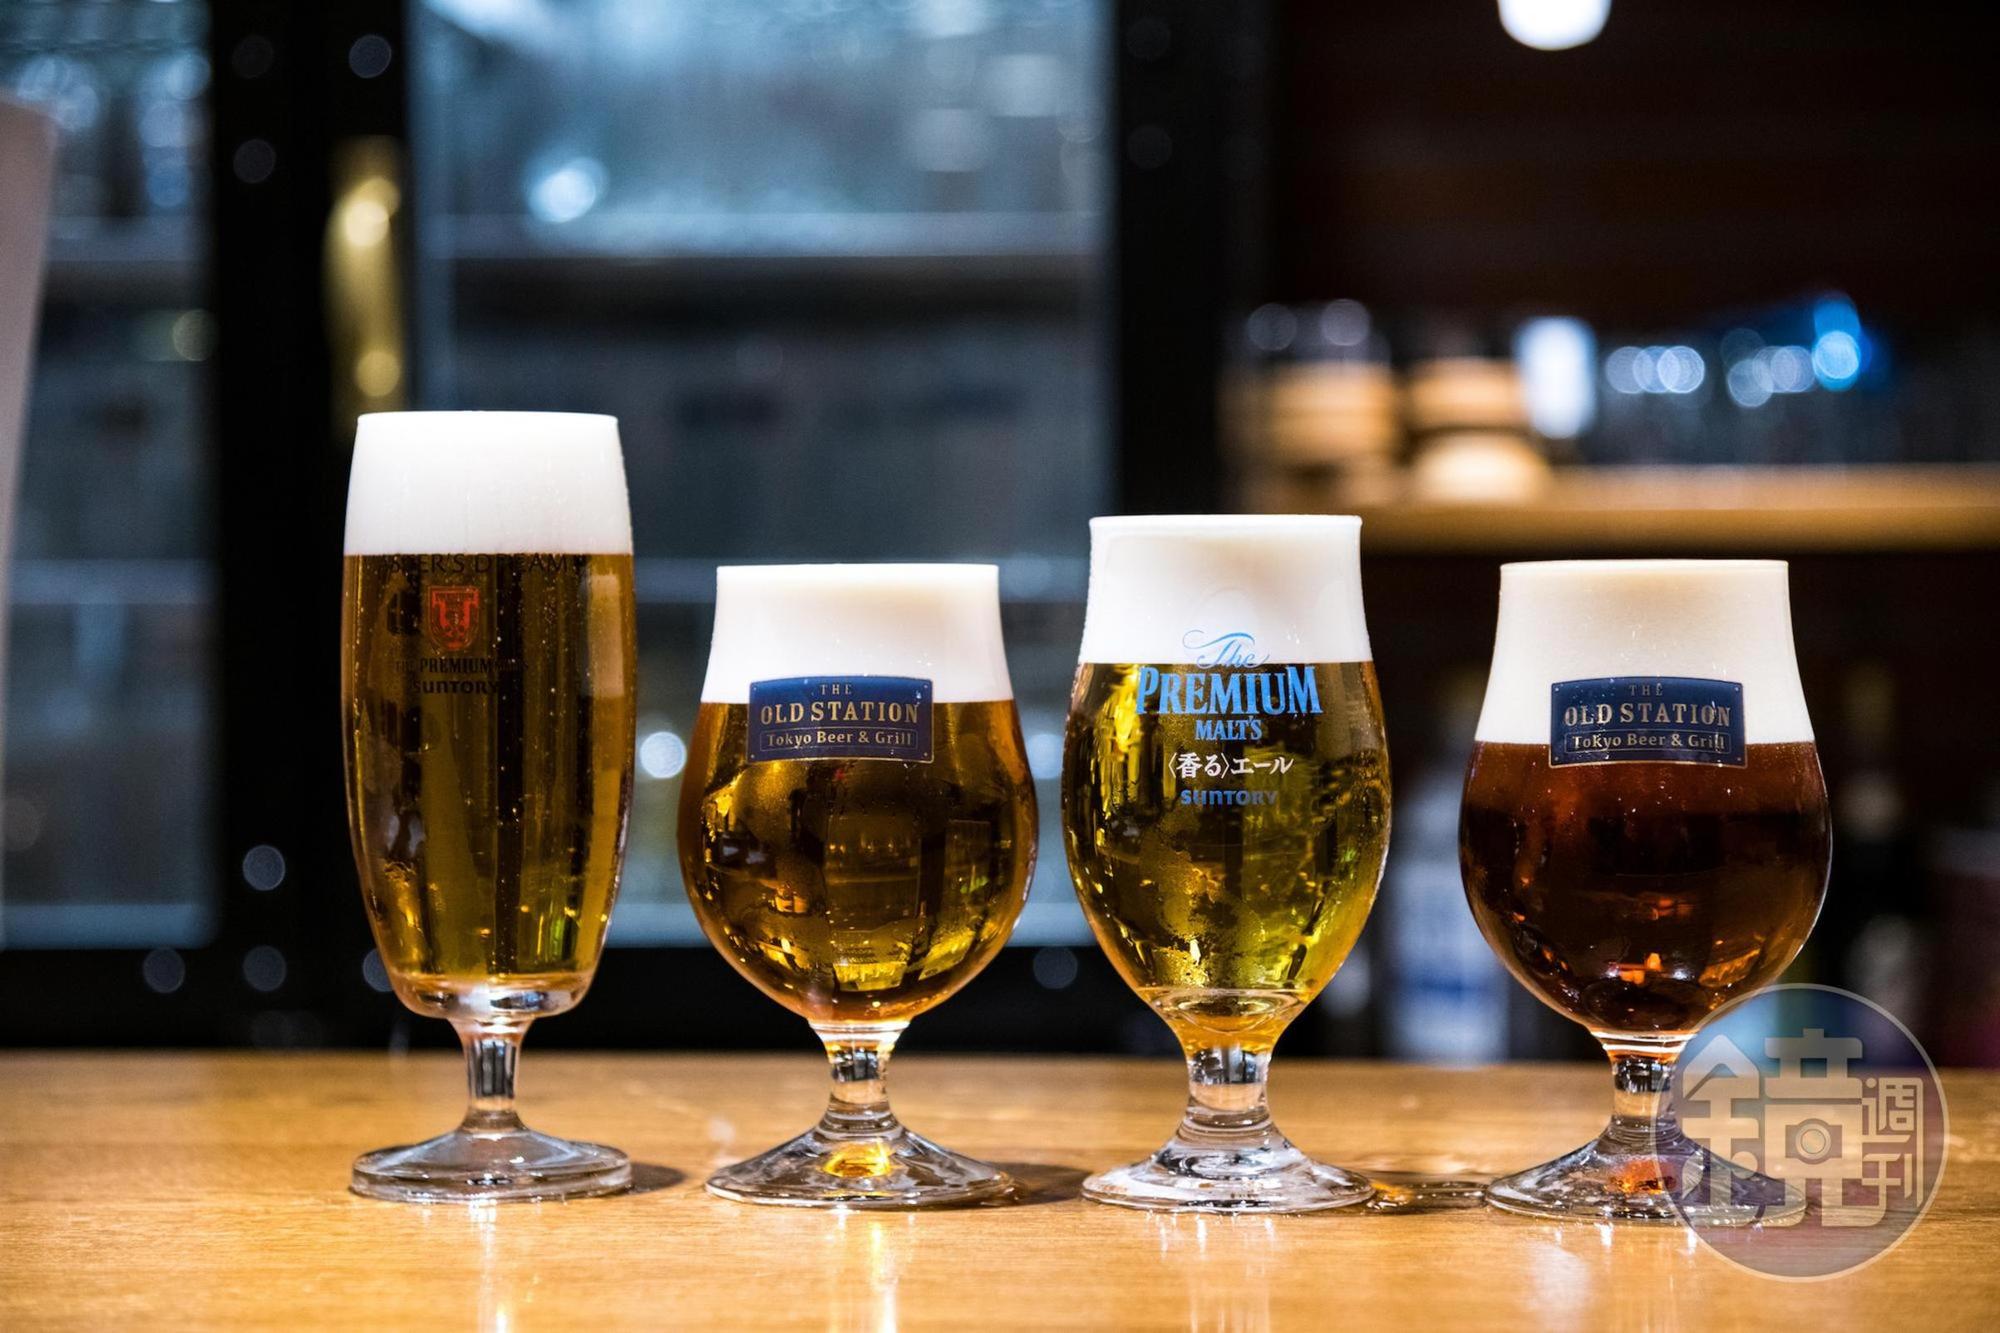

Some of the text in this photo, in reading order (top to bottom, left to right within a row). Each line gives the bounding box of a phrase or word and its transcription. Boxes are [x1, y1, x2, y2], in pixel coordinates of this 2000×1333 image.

[1182, 629, 1270, 669] The
[420, 657, 492, 674] PREMIUM
[820, 684, 853, 696] THE
[1135, 665, 1324, 716] PREMIUM
[1629, 683, 1663, 696] THE
[760, 701, 919, 725] OLD STATION
[1564, 702, 1731, 727] OLD STATION
[1194, 715, 1263, 741] MALT'S
[767, 730, 913, 748] Tokyo Beer & Grill
[1572, 733, 1725, 751] Tokyo Beer & Grill
